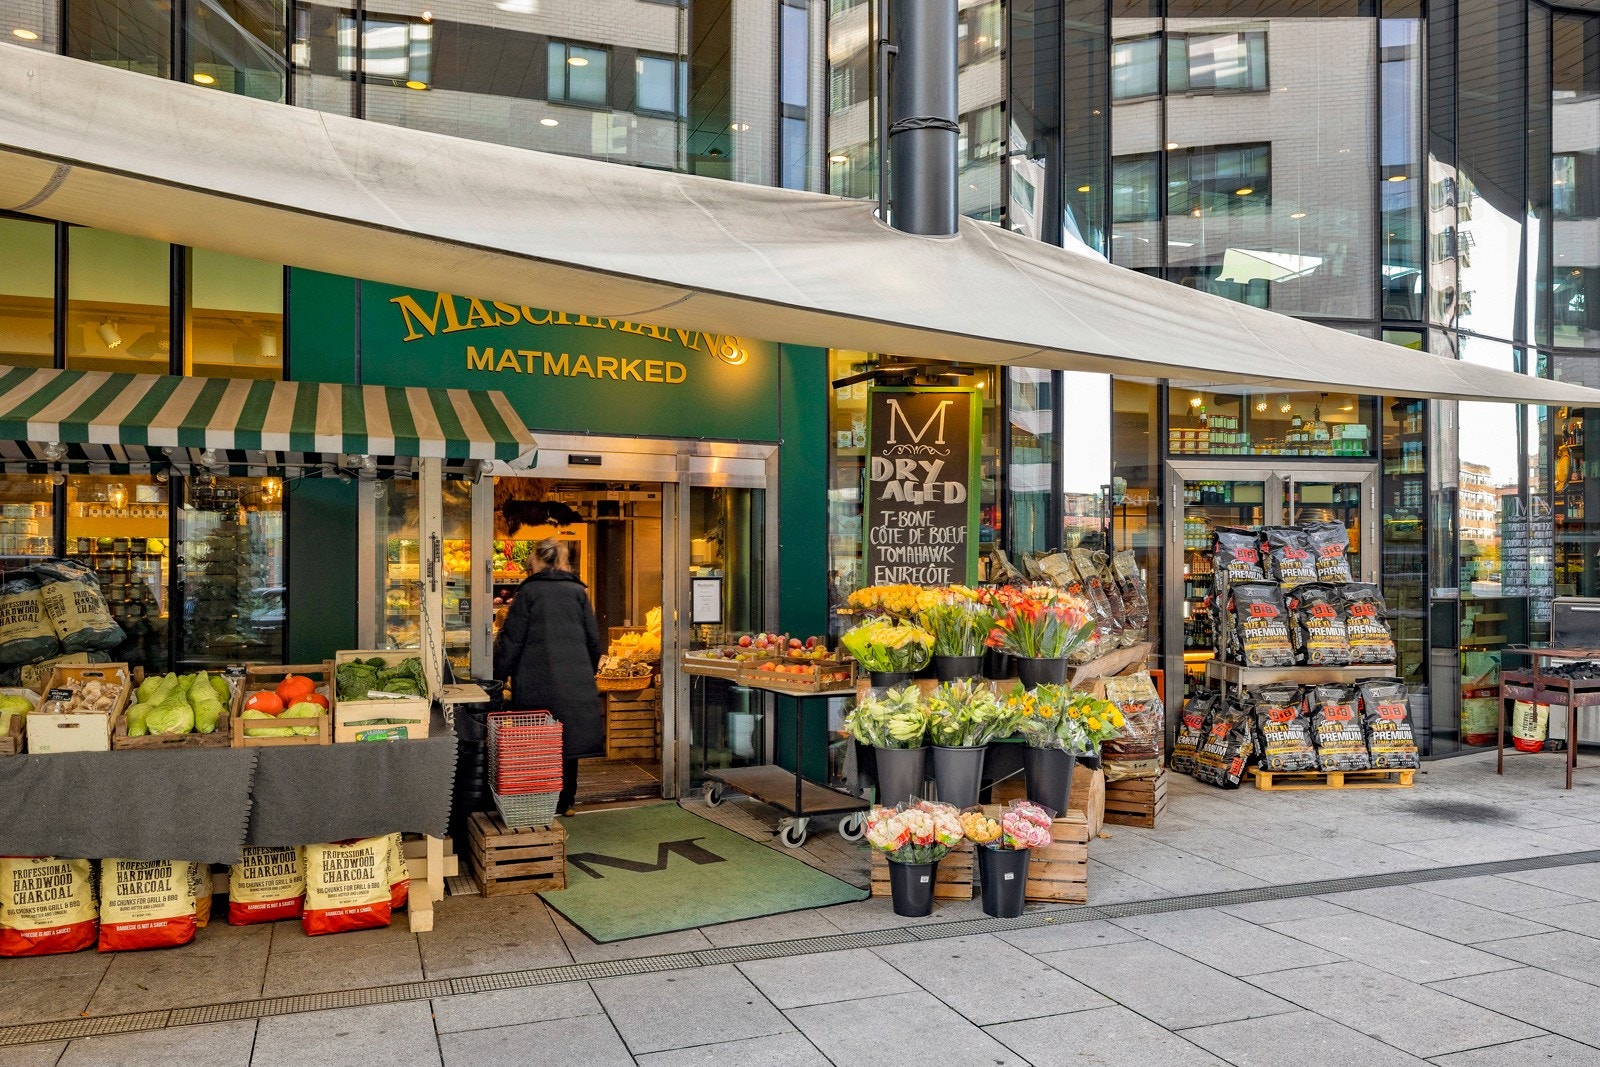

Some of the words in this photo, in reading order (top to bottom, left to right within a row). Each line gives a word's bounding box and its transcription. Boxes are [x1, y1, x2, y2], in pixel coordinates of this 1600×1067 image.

[466, 346, 687, 384] MATMARKED
[886, 398, 953, 444] M
[870, 456, 945, 485] DRY
[877, 480, 967, 505] AGED
[880, 510, 935, 527] T-BONE
[870, 525, 905, 545] CÔTE
[909, 528, 925, 545] DE
[929, 526, 967, 544] BOEUF
[877, 545, 955, 564] TOMAHAWK
[875, 563, 953, 585] ENTRECÔTE
[0, 605, 39, 617] ARDWOOD
[1245, 627, 1288, 638] PREMIUM
[1381, 706, 1401, 716] B&B
[1319, 731, 1362, 742] PREMIUM
[1373, 730, 1413, 740] PREMIUM
[243, 851, 297, 867] HARDWOOD
[322, 847, 374, 860] PROFESSIONAL
[567, 837, 727, 879] M
[13, 864, 72, 879] PROFESSIONAL
[116, 859, 172, 871] PROFESSIONAL
[243, 863, 297, 879] CHARCOAL
[322, 856, 375, 871] HARDWOOD
[13, 874, 73, 892] HARDWOOD
[117, 867, 172, 883] HARDWOOD
[323, 867, 375, 883] CHARCOAL
[13, 886, 74, 905] CHARCOAL
[116, 879, 172, 896] CHARCOAL
[324, 885, 343, 893] CHUNKS
[354, 882, 366, 890] GRILL
[117, 899, 136, 907] CHUNKS
[137, 897, 147, 905] FOR
[147, 896, 161, 904] GRILL
[16, 907, 36, 915] CHUNKS
[36, 905, 48, 913] FOR
